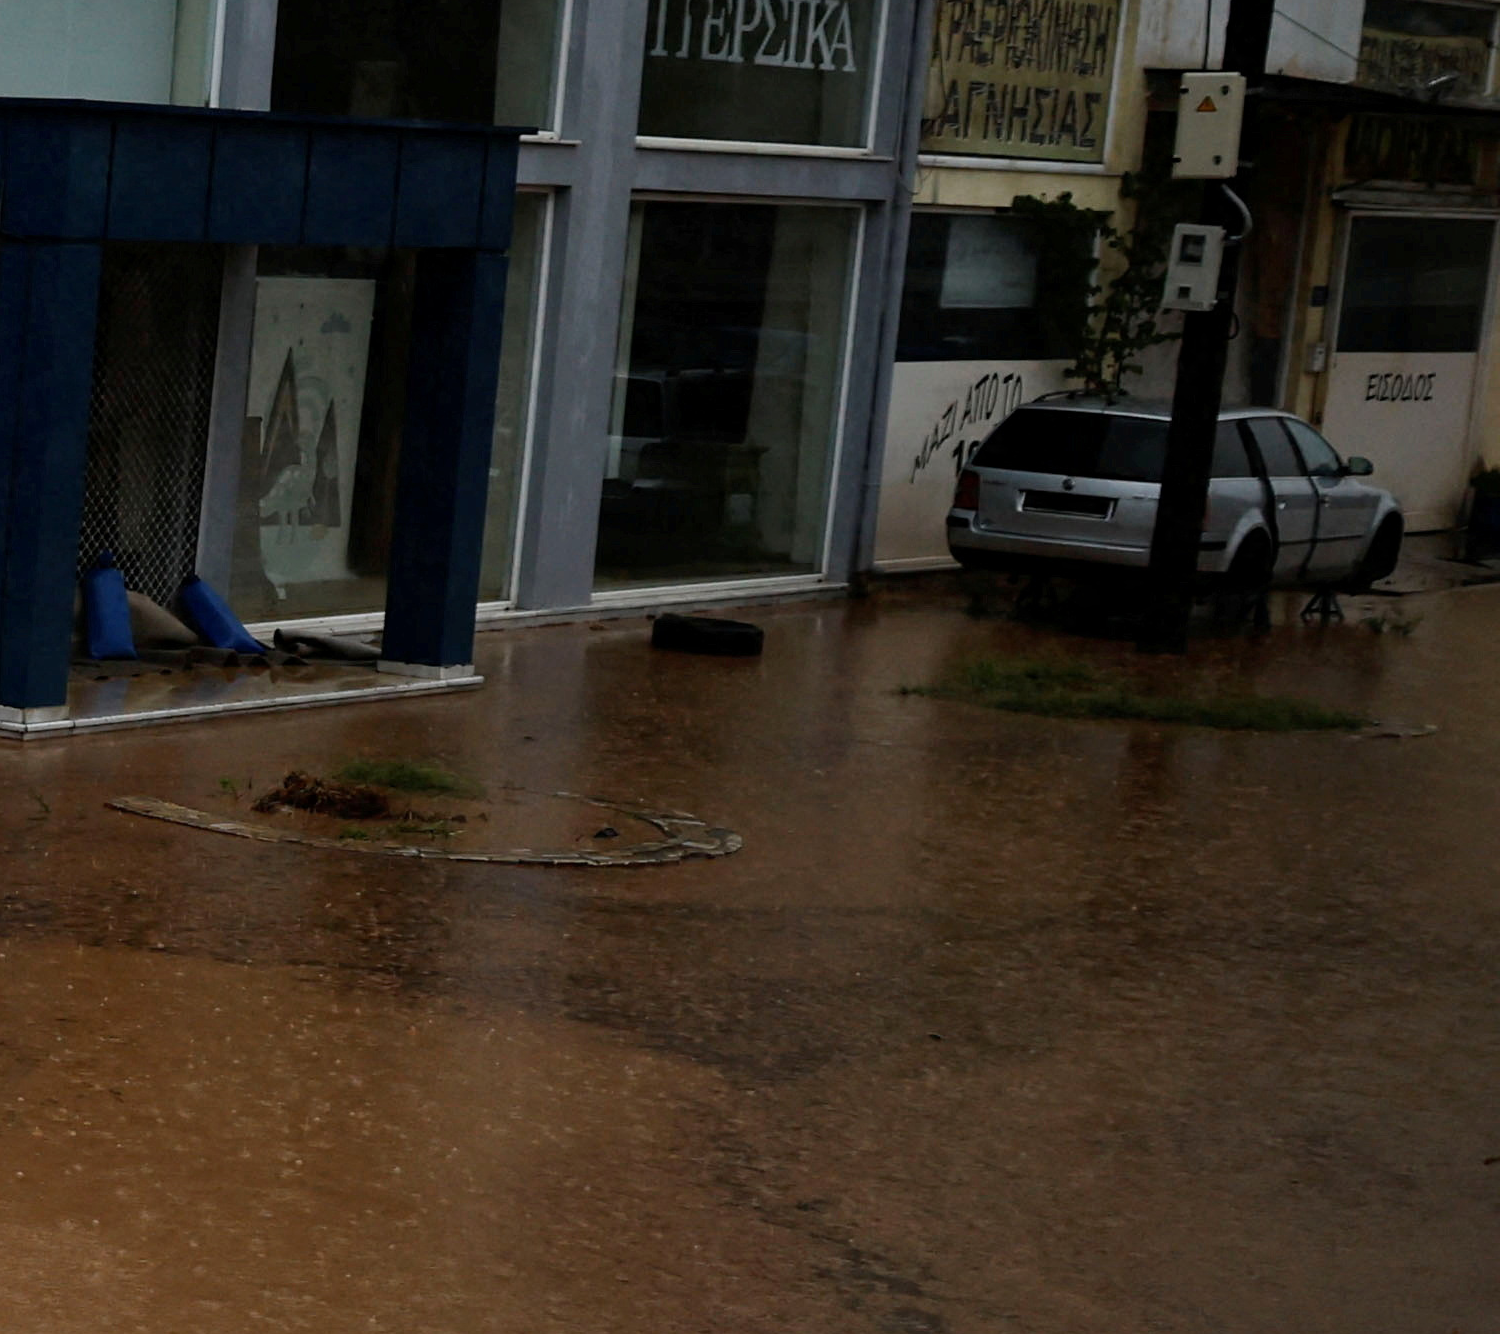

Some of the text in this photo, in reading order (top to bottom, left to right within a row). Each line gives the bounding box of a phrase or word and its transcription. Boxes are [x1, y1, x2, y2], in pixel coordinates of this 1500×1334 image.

[923, 79, 1102, 149] ΑΓΝΗΣΙΑΣ
[959, 371, 999, 431] ΑΠΟ
[1365, 371, 1437, 402] ΕΙΣΟΔΟΣ
